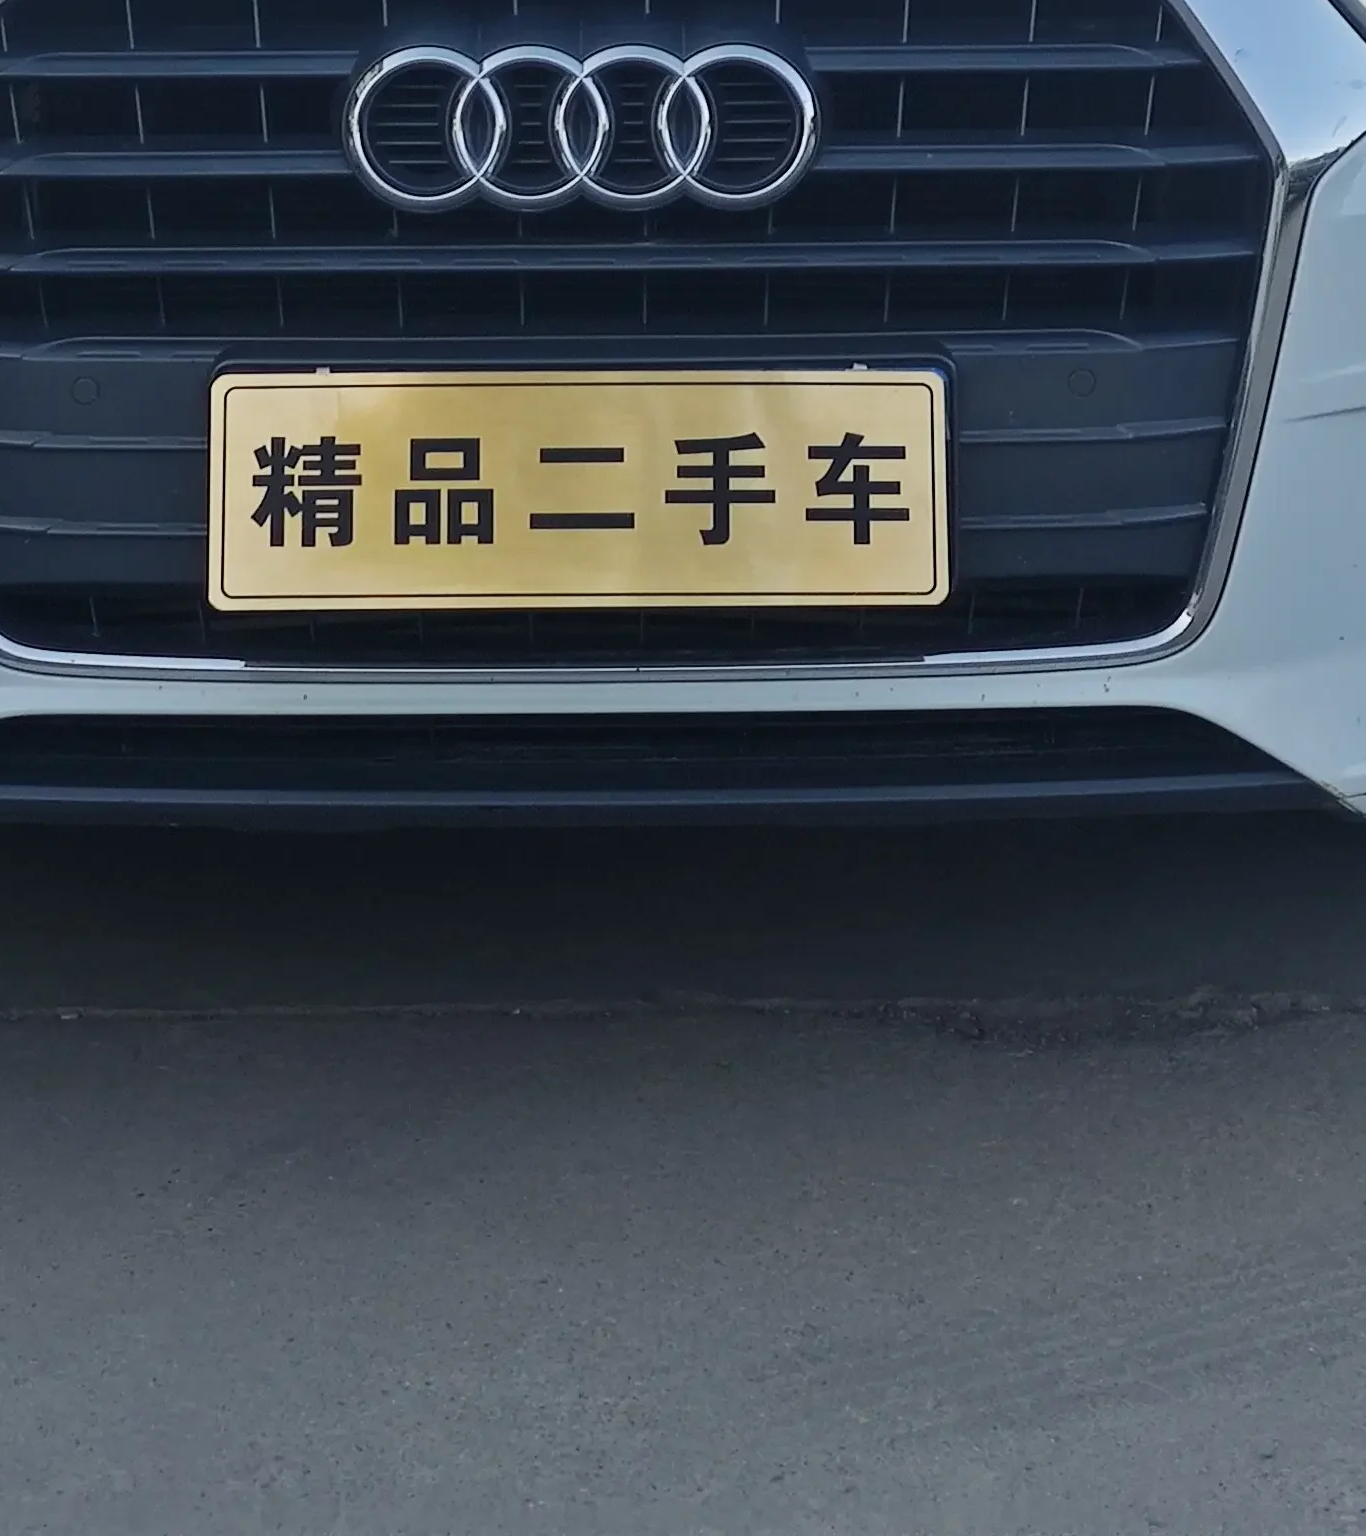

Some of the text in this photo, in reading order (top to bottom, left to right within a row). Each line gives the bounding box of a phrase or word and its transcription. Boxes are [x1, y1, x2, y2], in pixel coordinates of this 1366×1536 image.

[250, 431, 911, 547] 精品二手车
